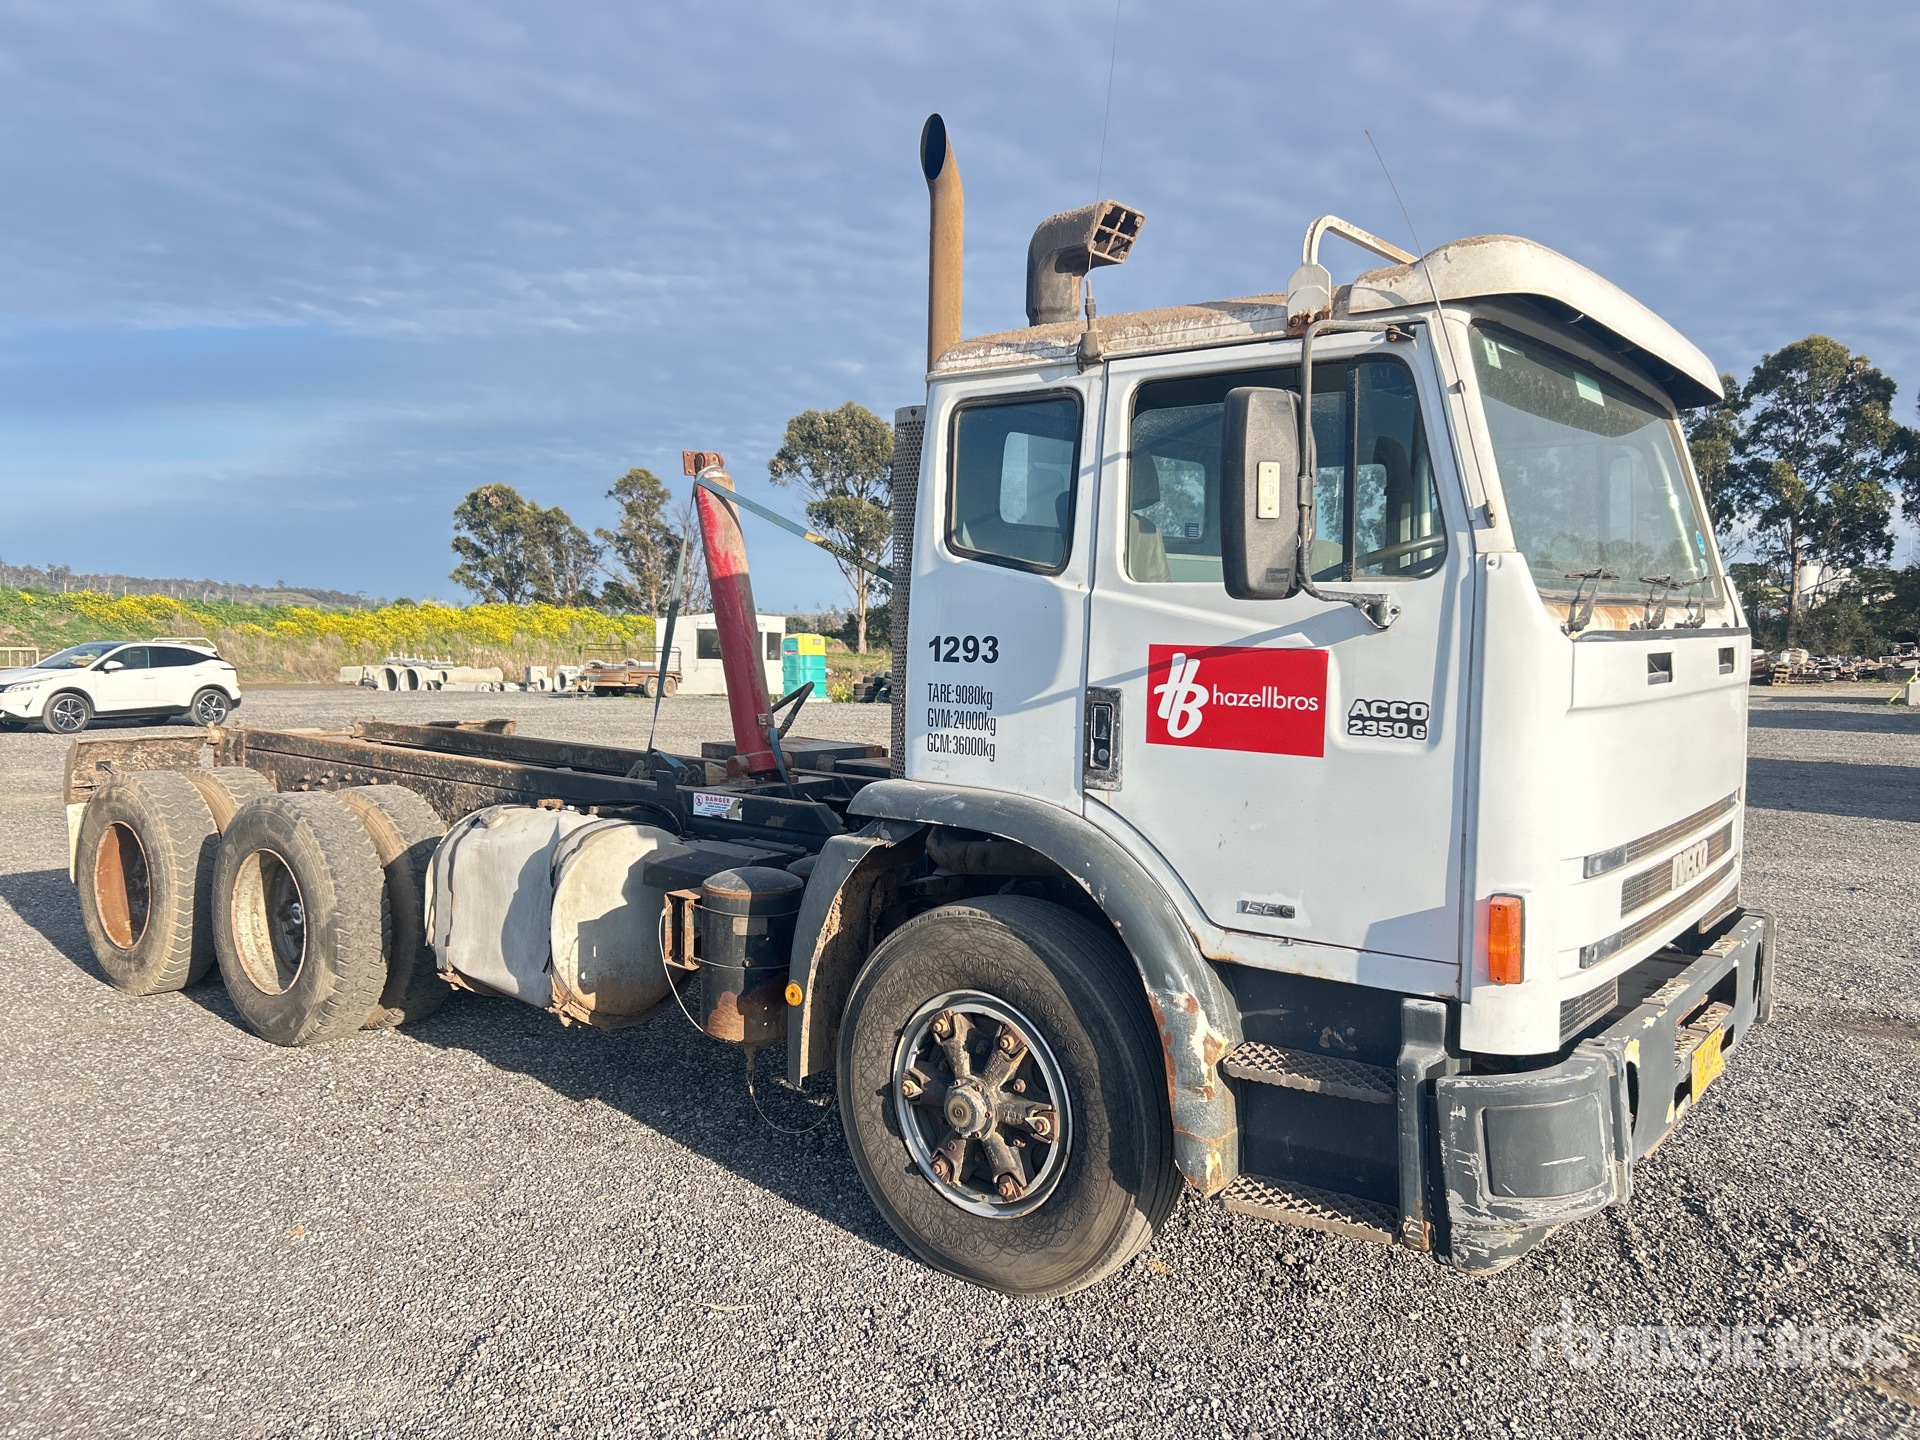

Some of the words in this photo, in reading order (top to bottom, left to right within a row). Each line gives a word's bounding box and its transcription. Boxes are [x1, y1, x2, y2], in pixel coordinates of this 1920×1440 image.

[928, 634, 999, 664] 1293
[1212, 683, 1319, 712] hazellbros
[1348, 699, 1429, 720] ACCO
[1348, 719, 1408, 738] 2350
[1411, 724, 1427, 740] G
[1671, 839, 1708, 891] IVECO
